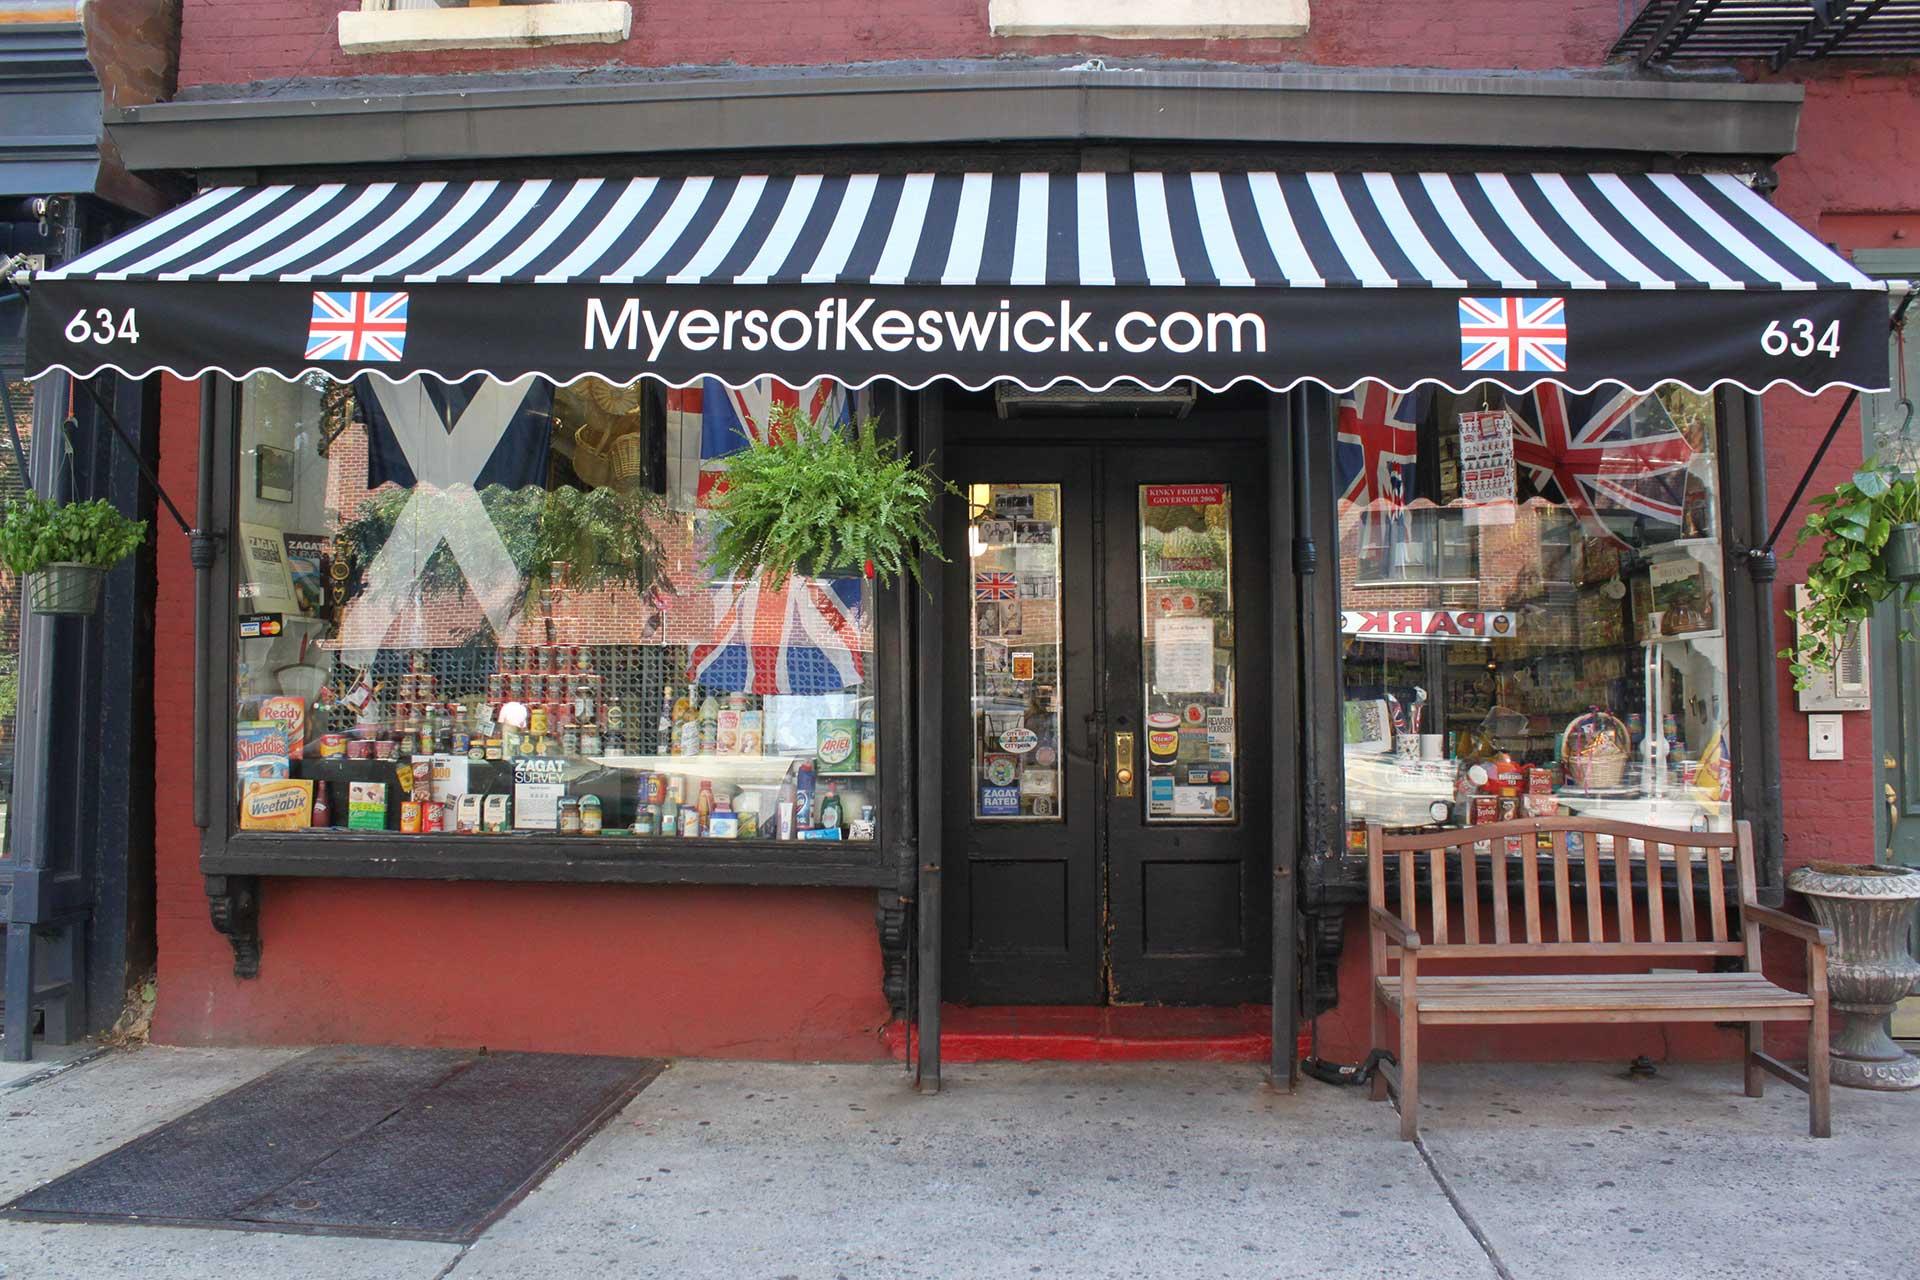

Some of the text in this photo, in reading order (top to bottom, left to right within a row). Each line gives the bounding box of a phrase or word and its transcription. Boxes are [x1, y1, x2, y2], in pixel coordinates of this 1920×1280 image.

[64, 307, 140, 345] 634
[583, 296, 1267, 362] MyersofKeswick.com
[1760, 318, 1841, 358] 634
[1150, 487, 1220, 496] KINKY FRIEDMAN
[1153, 496, 1199, 504] GOVERNOR
[288, 540, 322, 550] ZAGAT
[264, 707, 302, 721] Ready
[238, 736, 287, 762] Shreddies
[820, 738, 850, 753] ARIEL
[515, 760, 565, 773] ZAGAT
[514, 771, 565, 784] SURVEY
[983, 789, 1018, 798] ZAGAT
[251, 796, 306, 816] Weetabix
[984, 797, 1018, 806] RATED
